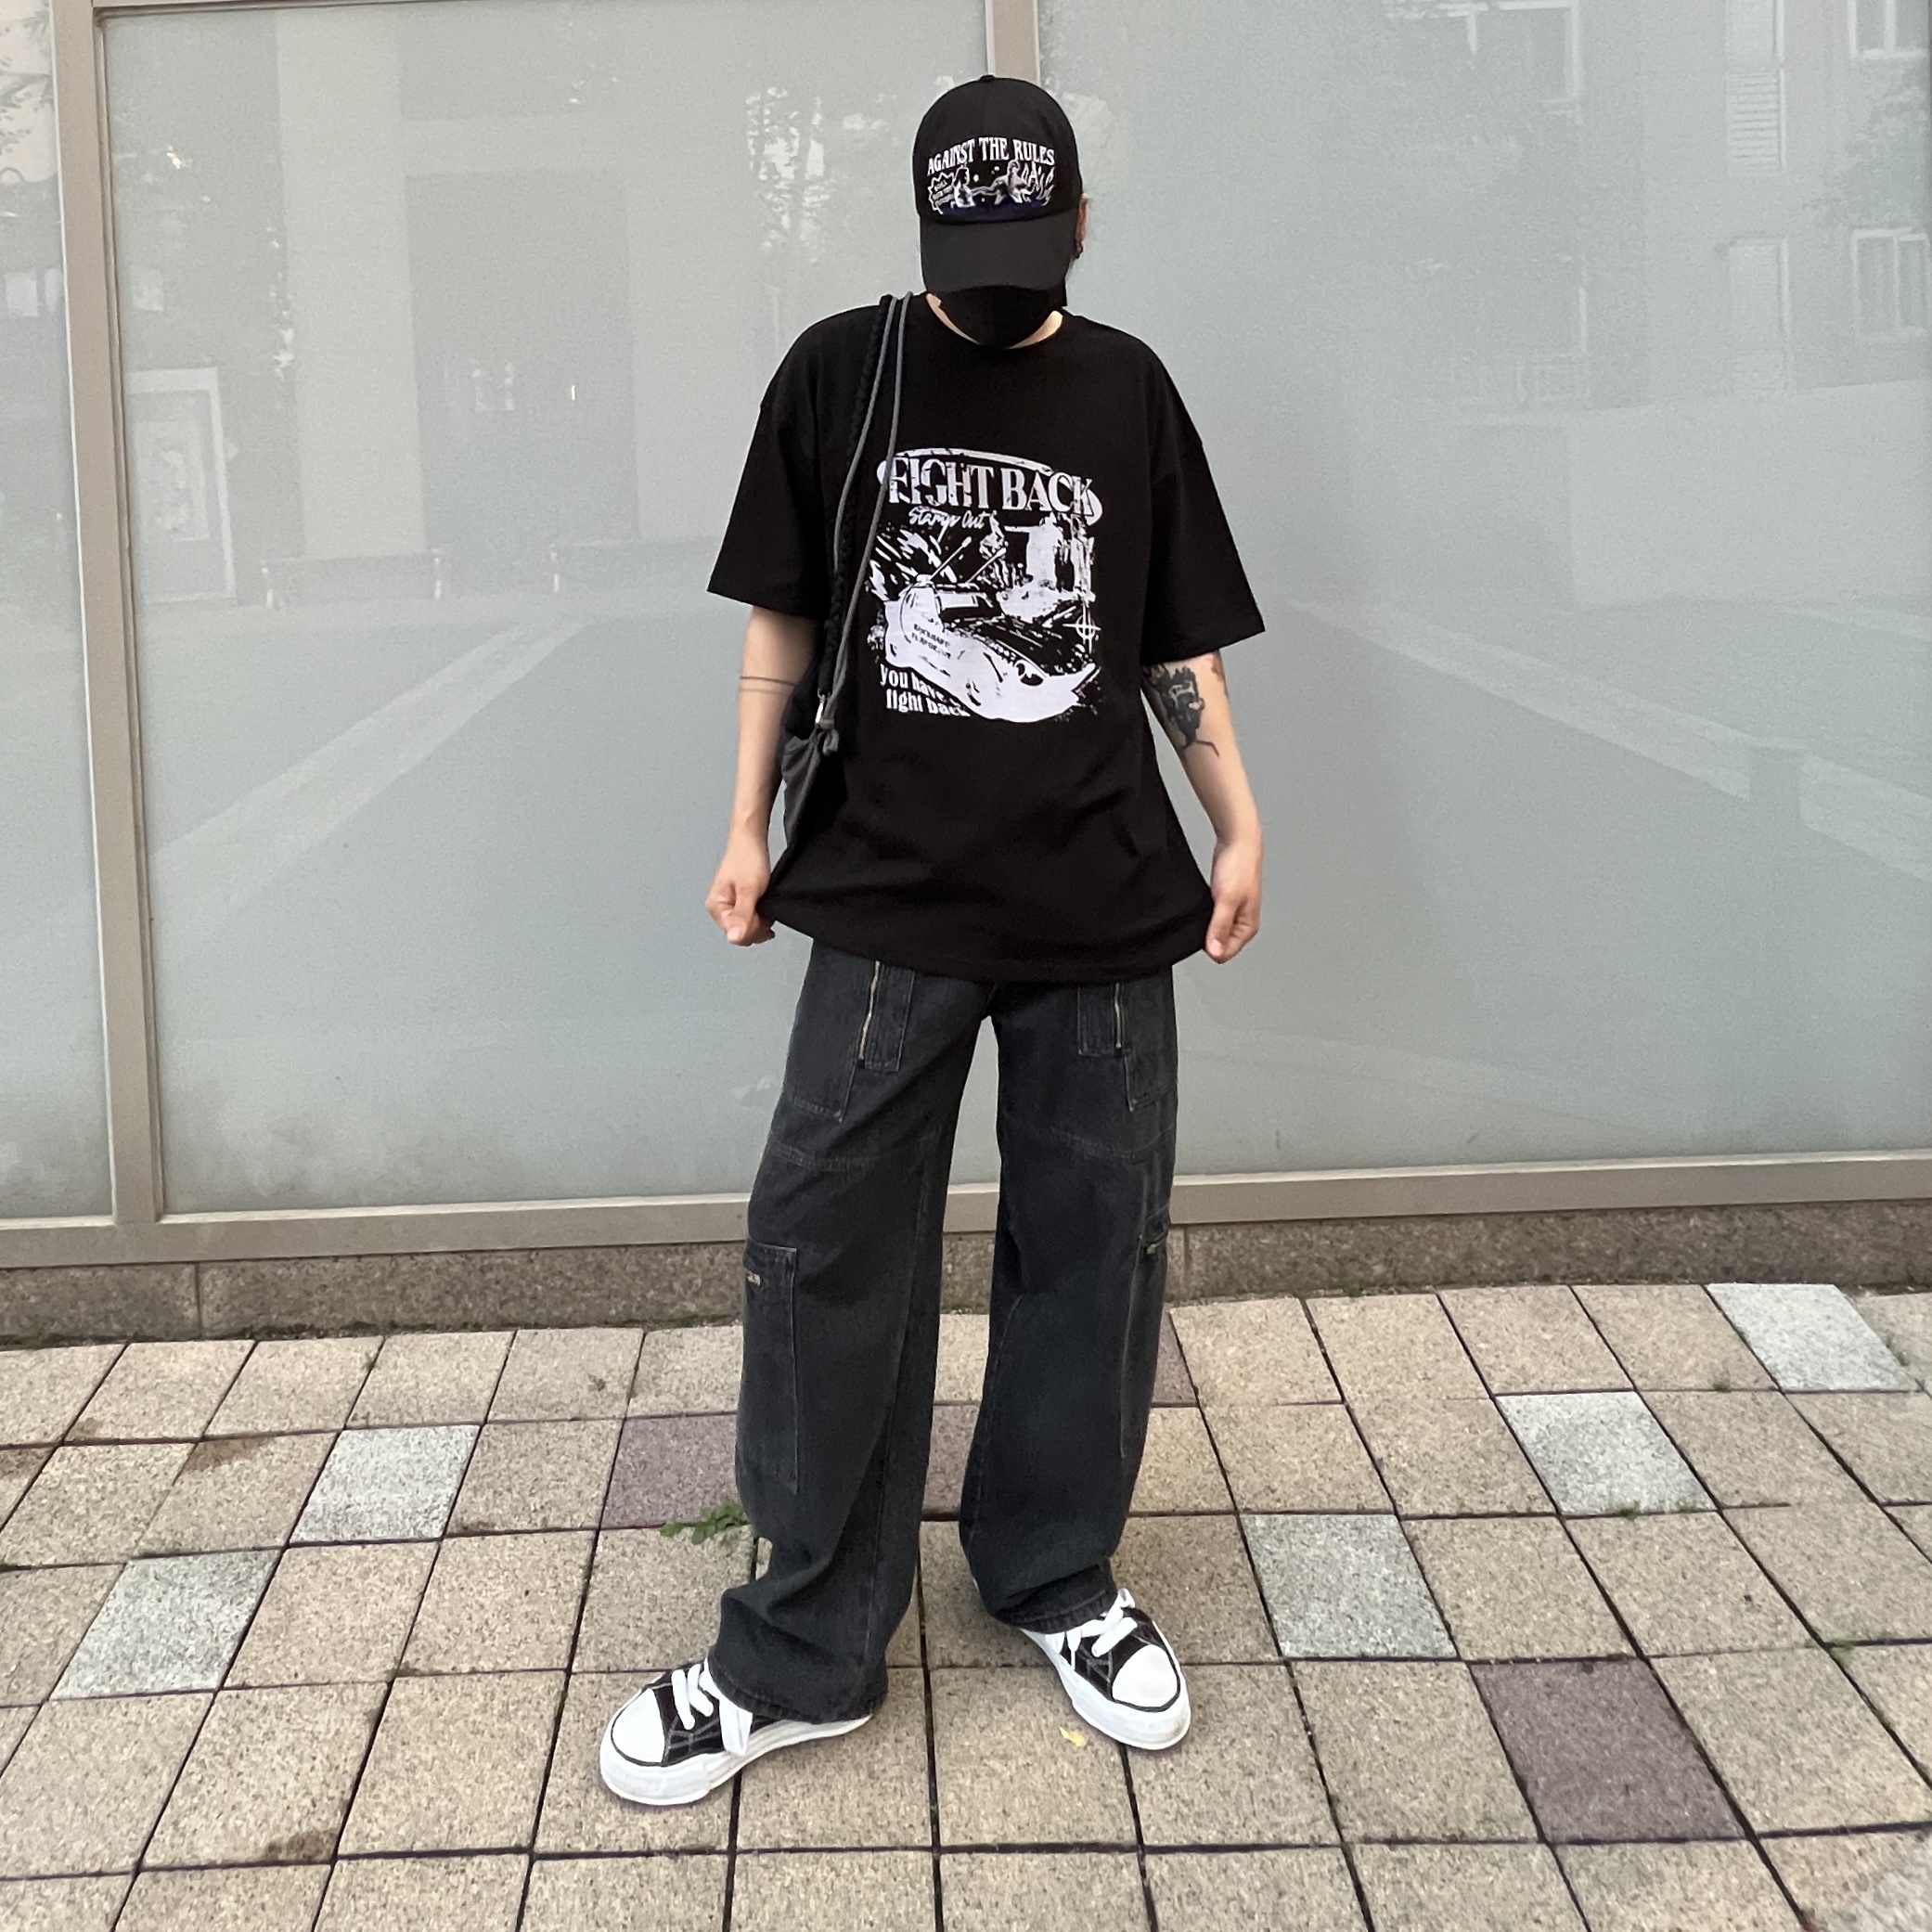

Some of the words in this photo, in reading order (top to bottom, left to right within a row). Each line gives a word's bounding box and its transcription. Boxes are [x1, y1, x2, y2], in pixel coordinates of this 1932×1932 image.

[927, 139, 975, 176] AGAINST
[978, 137, 1010, 161] THE
[1012, 139, 1055, 165] RULES
[888, 457, 995, 509] FIGHT
[1000, 468, 1095, 516] BACK
[880, 663, 908, 689] you
